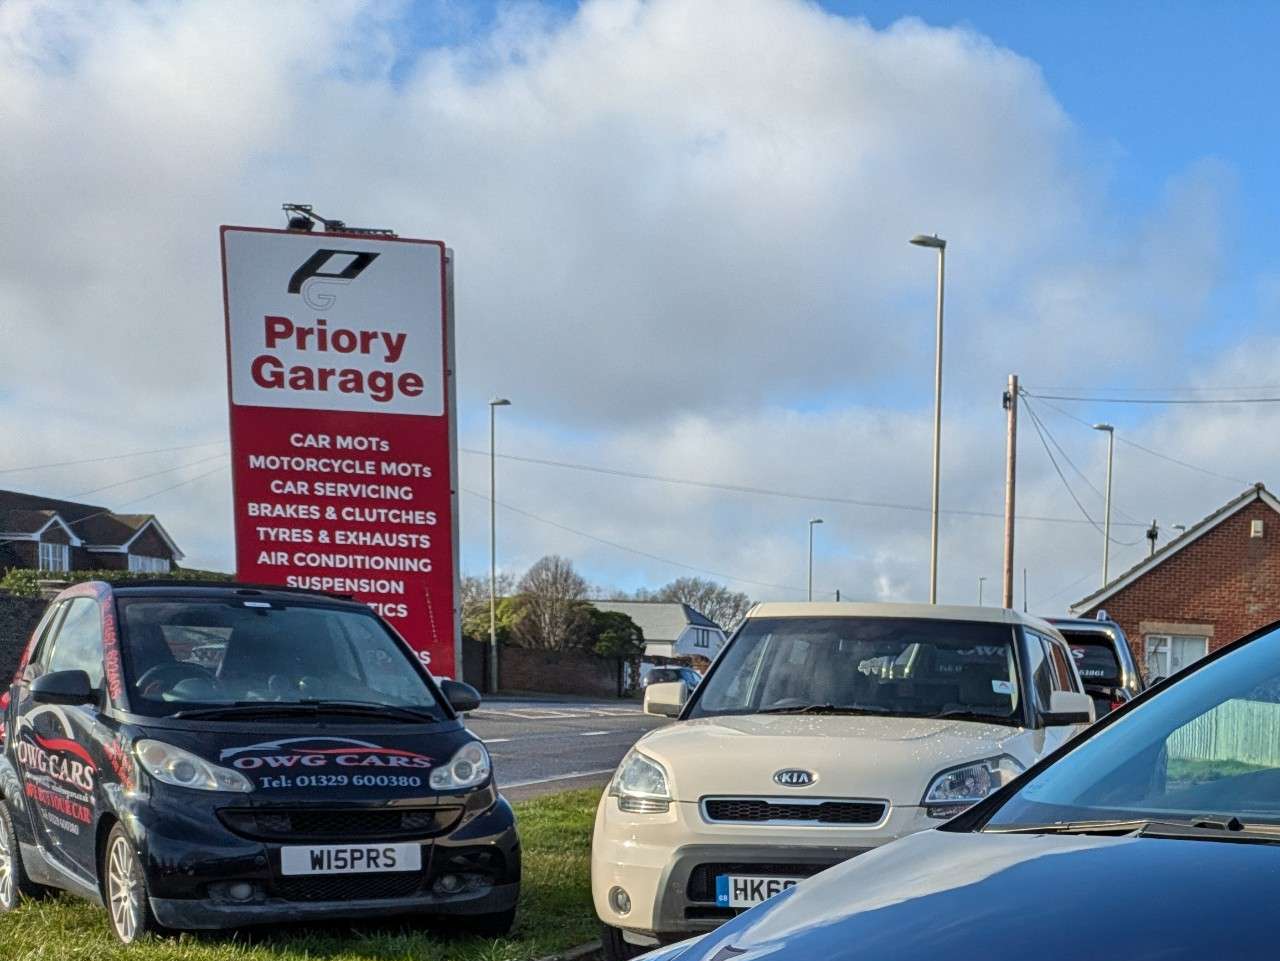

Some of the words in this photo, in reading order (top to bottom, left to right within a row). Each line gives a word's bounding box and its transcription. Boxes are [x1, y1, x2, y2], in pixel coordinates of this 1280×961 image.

[264, 315, 407, 363] Priory
[251, 355, 424, 402] Garage
[290, 433, 331, 449] CAR
[336, 436, 390, 451] MOTs
[249, 455, 376, 475] MOTORCYCLE
[381, 461, 432, 478] MOTs
[270, 480, 309, 495] CAR
[314, 482, 413, 500] SERVICING
[248, 503, 320, 519] BRAKES
[325, 507, 337, 520] &
[342, 507, 437, 525] CLUTCHES
[256, 527, 313, 543] TYRES
[318, 530, 331, 544] &
[335, 531, 431, 549] EXHAUSTS
[257, 551, 289, 566] AIR
[293, 553, 432, 573] CONDITIONING
[286, 576, 404, 594] SUSPENSION
[18, 740, 47, 774] OWG
[49, 755, 94, 792] CARS
[233, 755, 328, 769] OWG
[335, 754, 433, 769] CARS
[259, 776, 292, 788] Tel:
[295, 775, 349, 787] 01329
[352, 775, 422, 787] 600380
[781, 772, 809, 783] KIA
